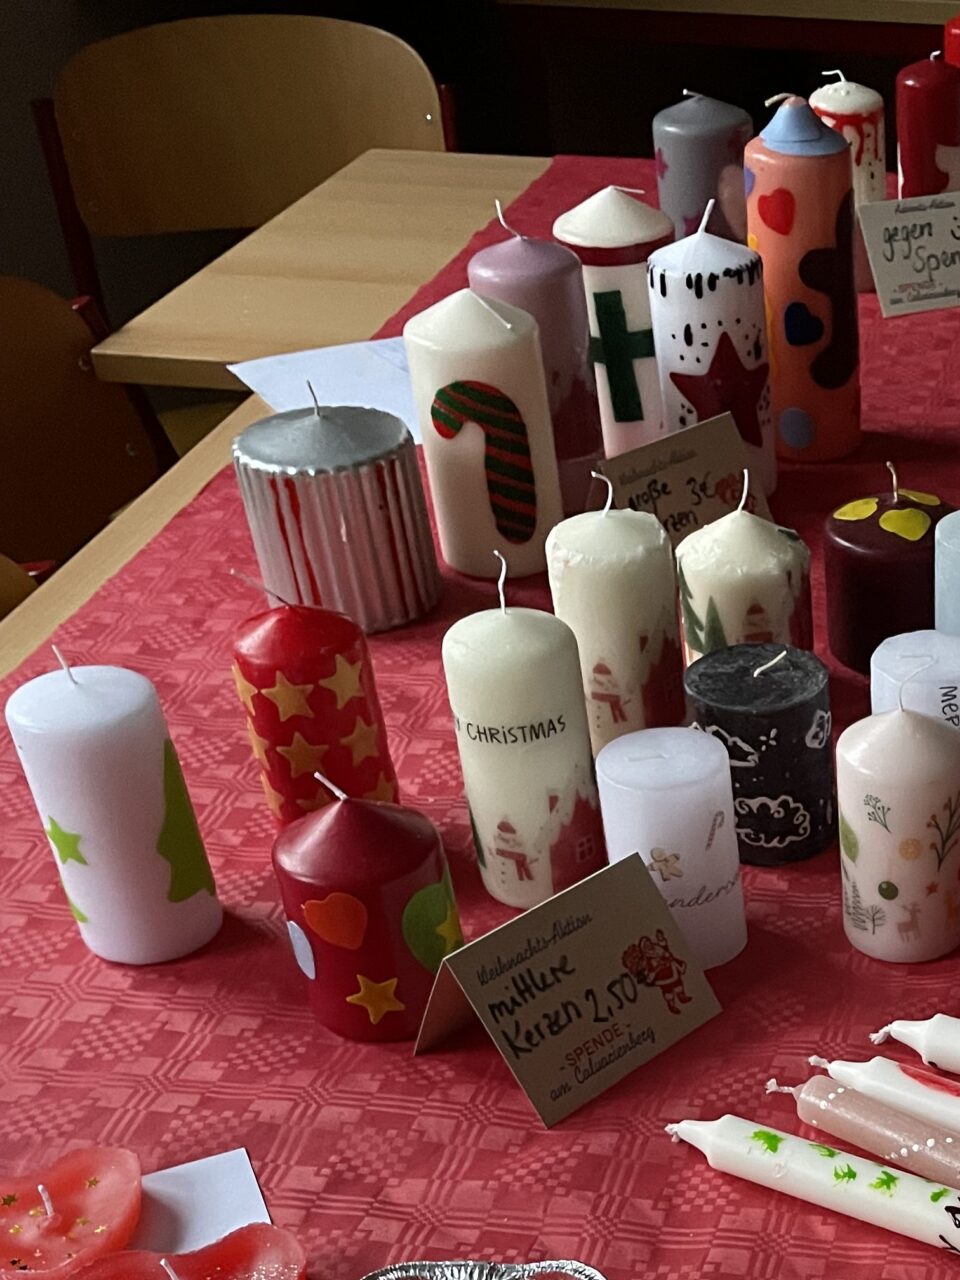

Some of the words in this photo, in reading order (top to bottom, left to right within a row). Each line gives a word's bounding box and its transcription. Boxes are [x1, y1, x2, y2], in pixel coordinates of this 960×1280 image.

[883, 222, 932, 262] gegen
[663, 510, 698, 533] rzen
[488, 955, 576, 1023] mittlere
[502, 1000, 582, 1059] Kerzen
